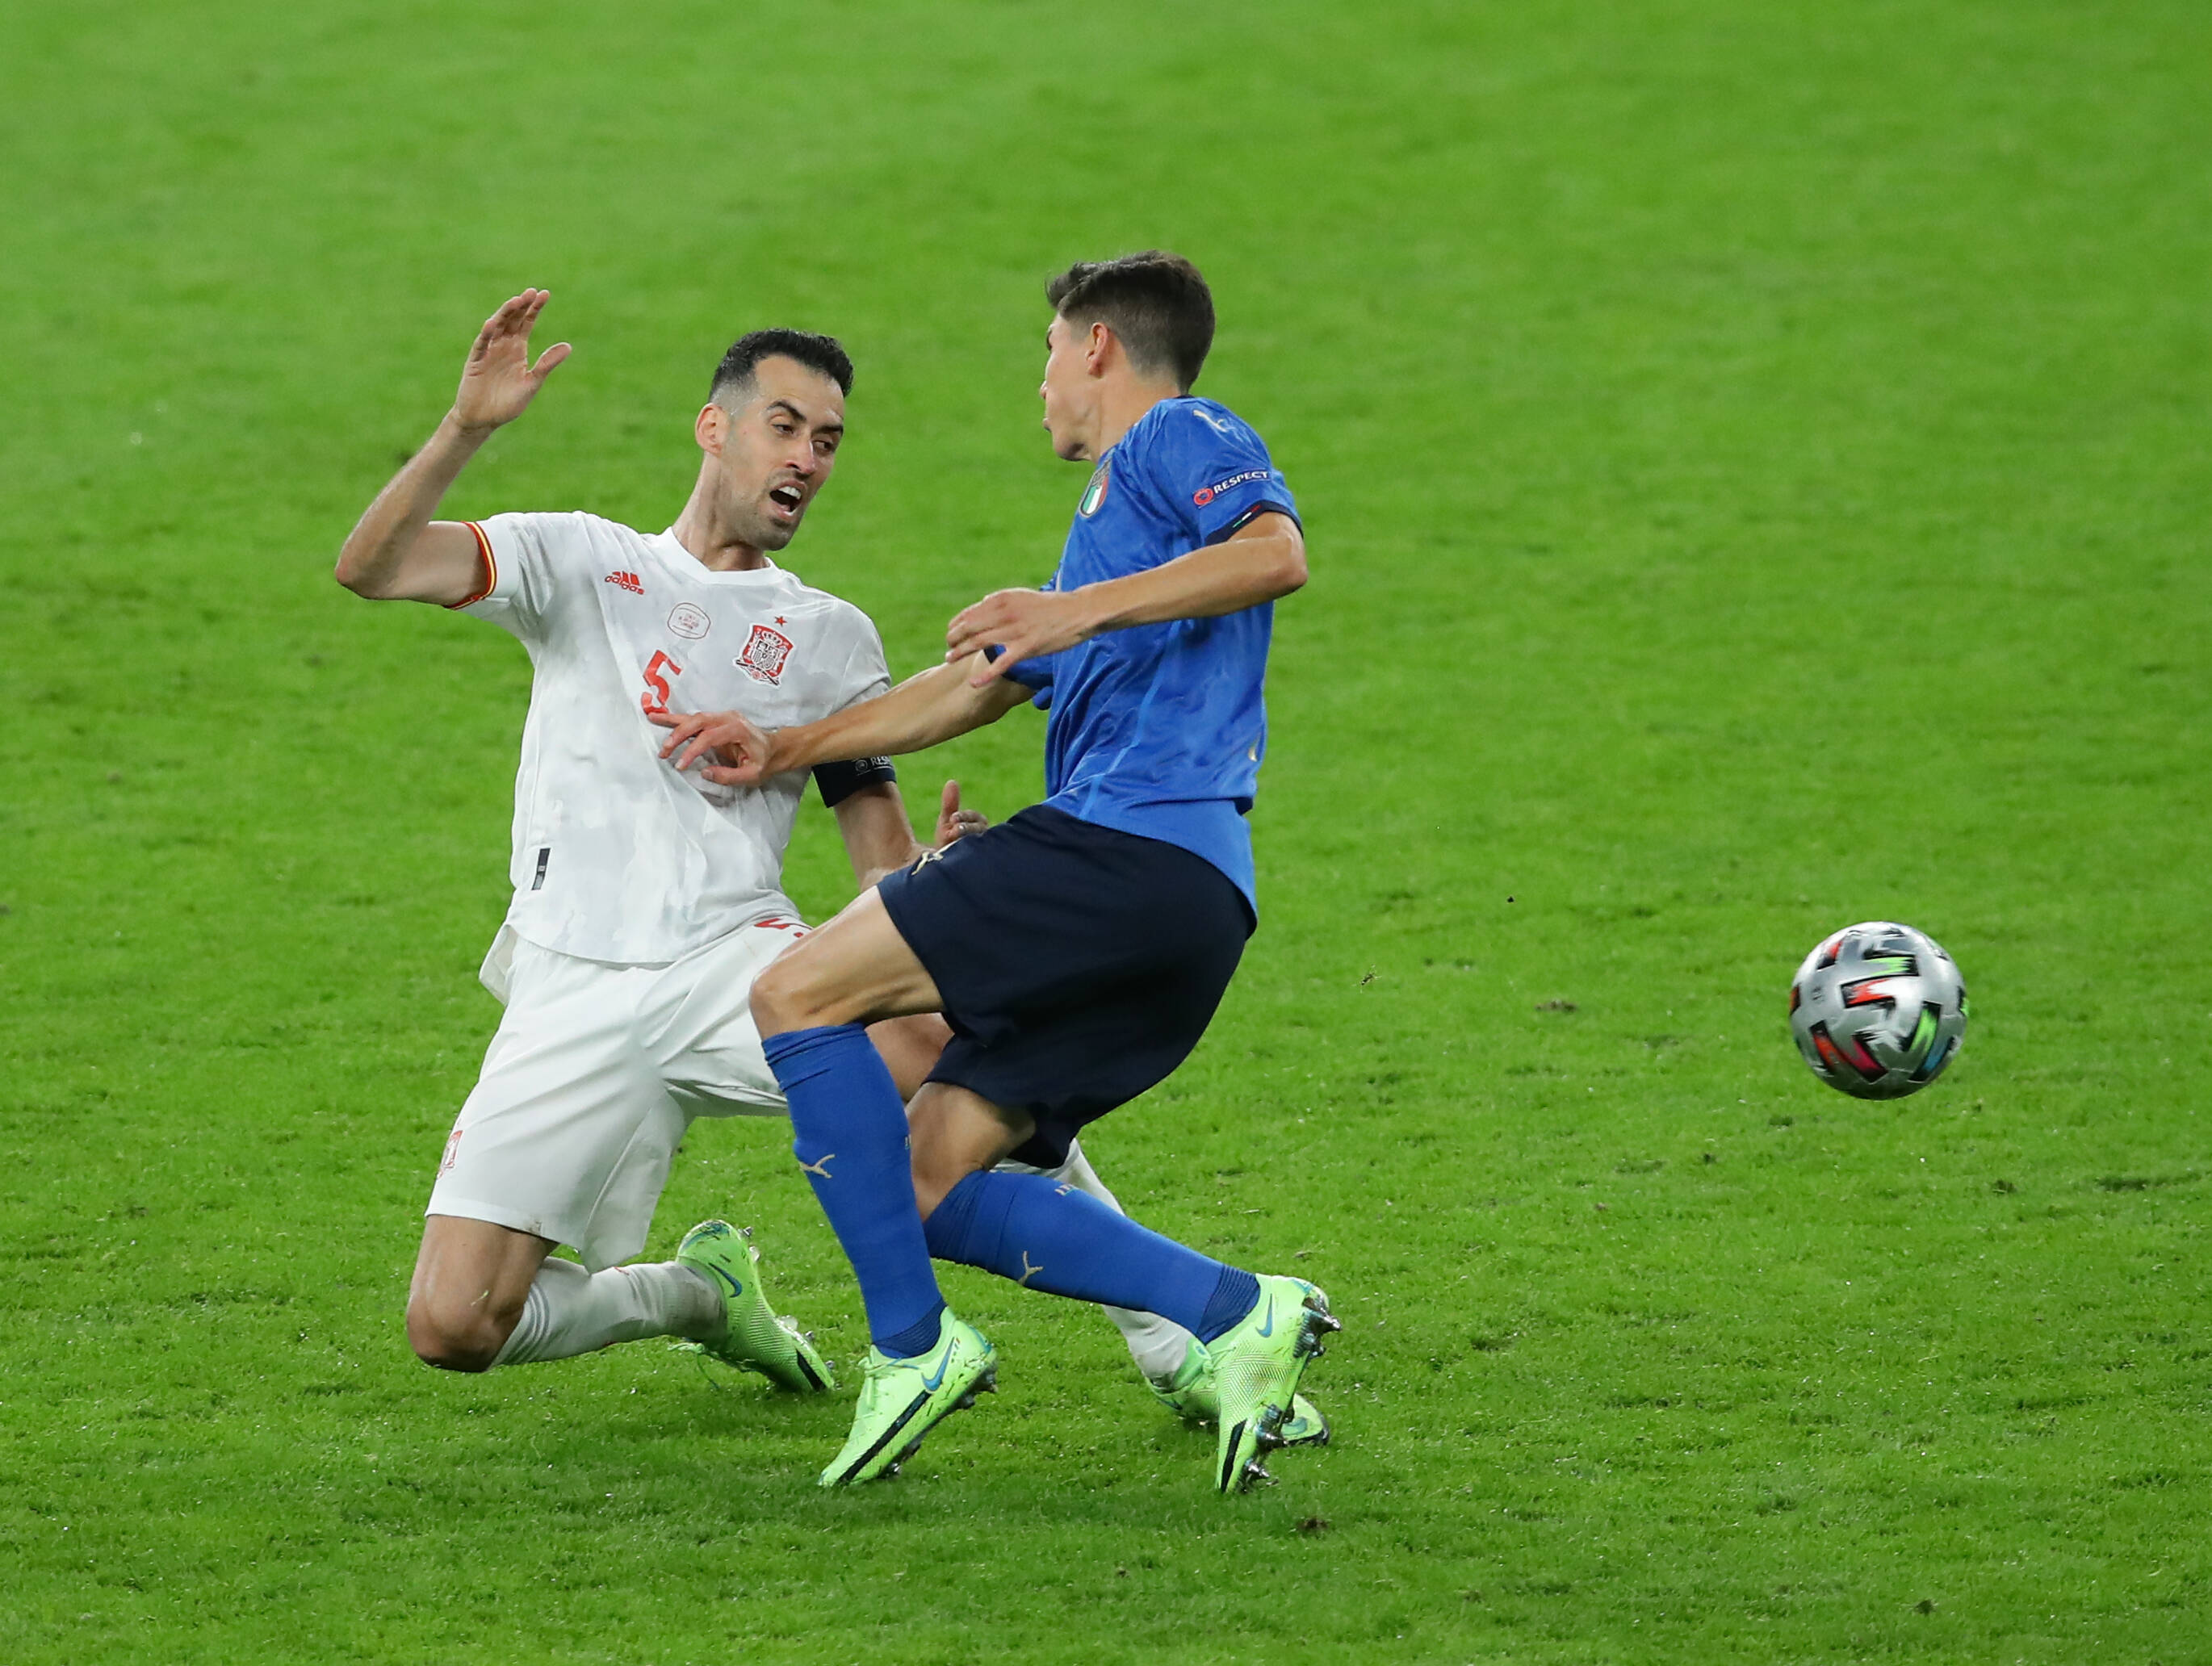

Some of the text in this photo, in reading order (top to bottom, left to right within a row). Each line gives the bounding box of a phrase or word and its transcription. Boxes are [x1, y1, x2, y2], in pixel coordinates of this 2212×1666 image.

[1213, 471, 1267, 494] RESPECT
[605, 575, 645, 595] adidas
[641, 649, 682, 715] 5
